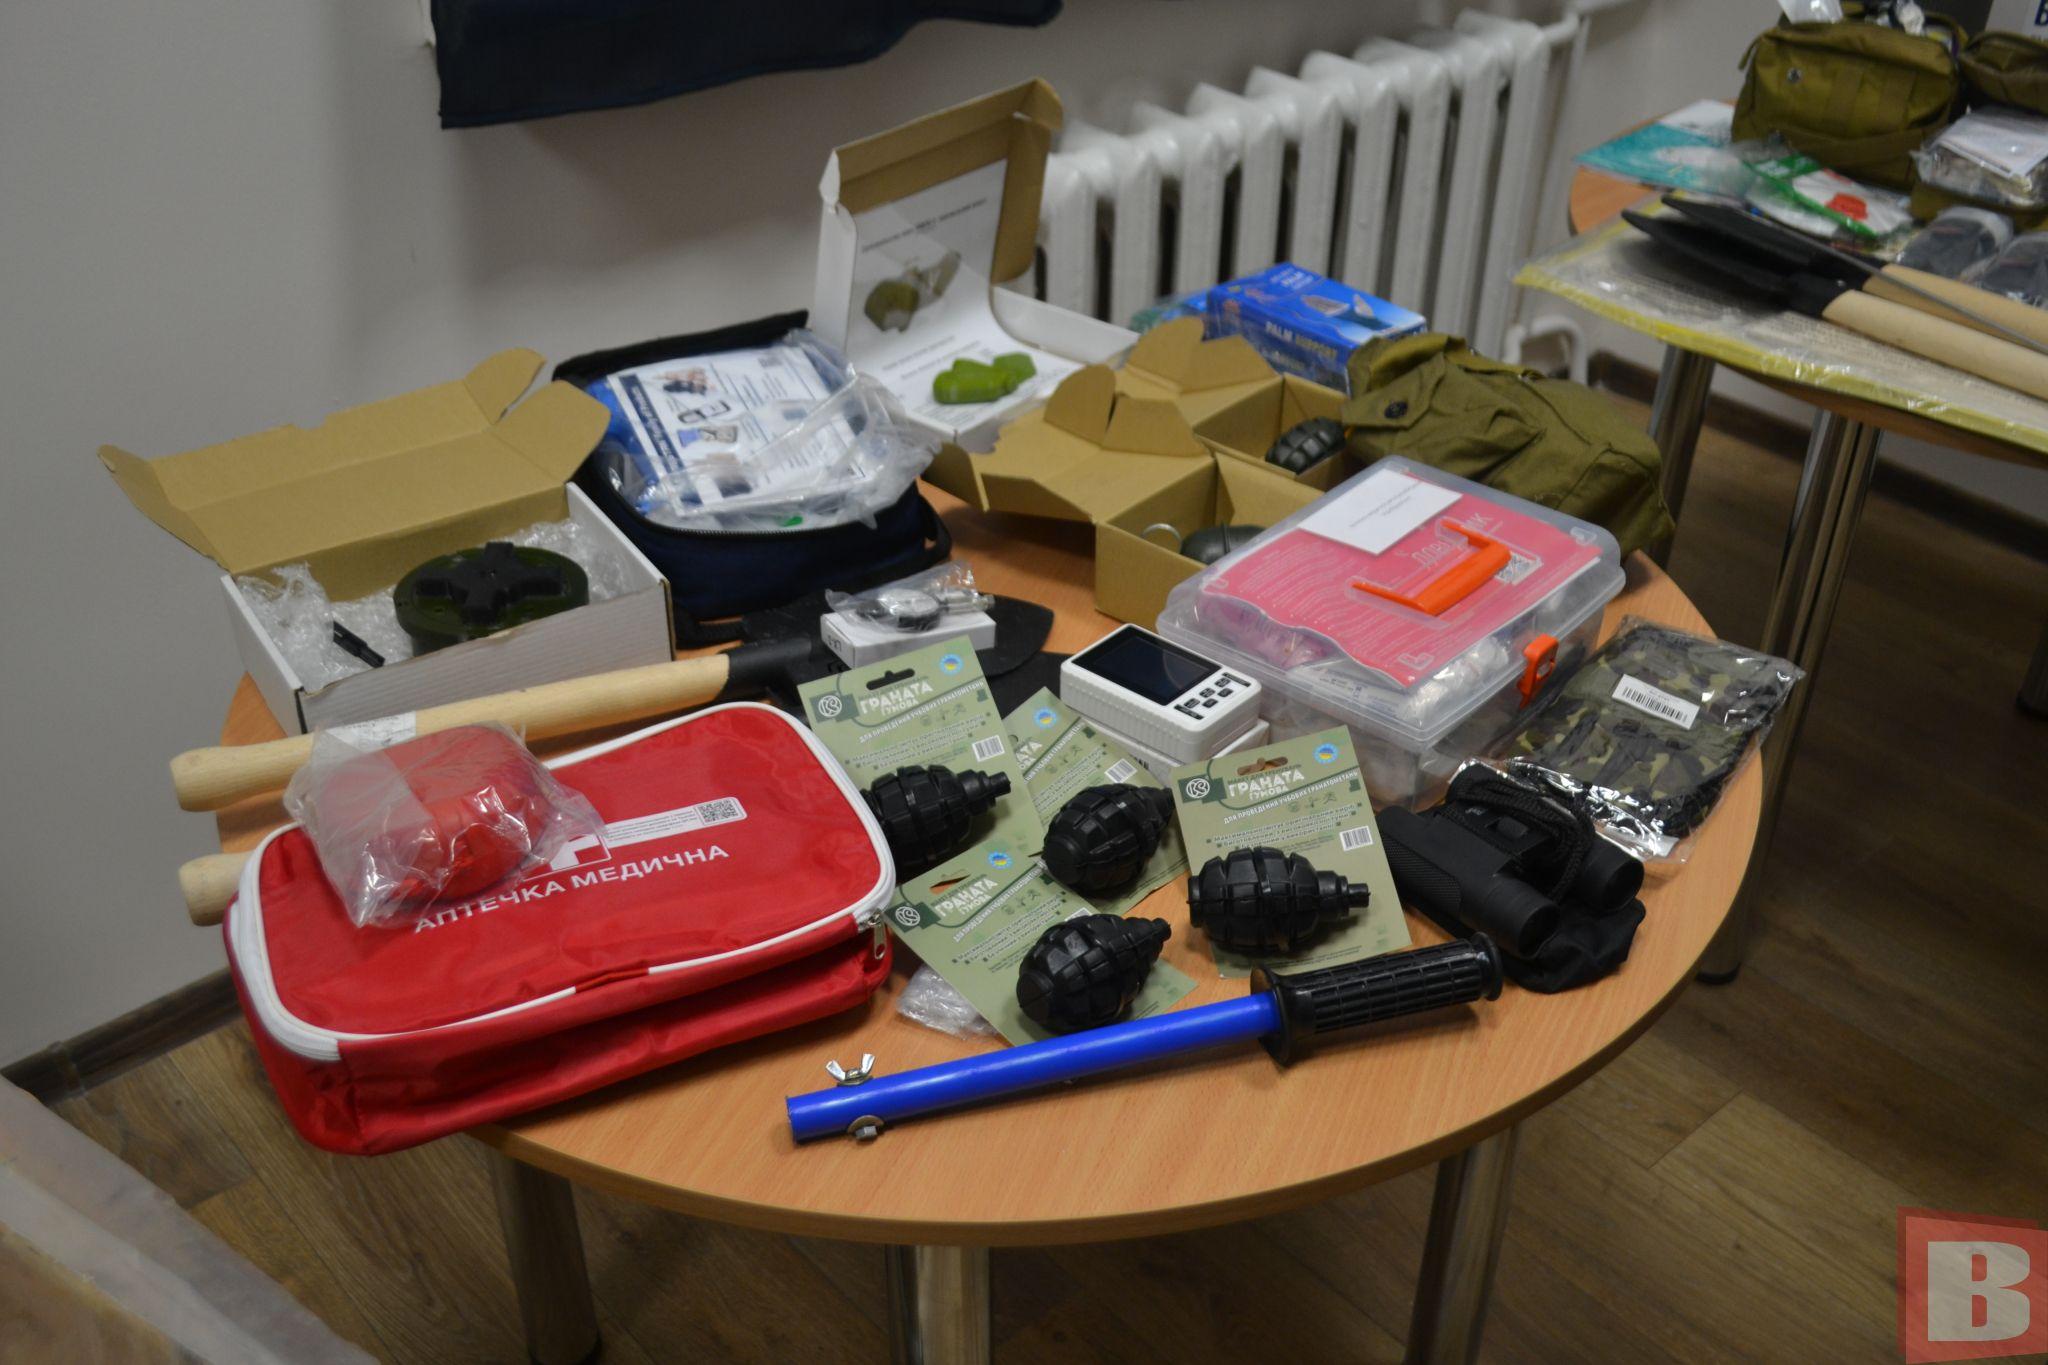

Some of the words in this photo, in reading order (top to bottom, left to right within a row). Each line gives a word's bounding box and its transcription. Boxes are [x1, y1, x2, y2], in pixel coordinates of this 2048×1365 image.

[860, 681, 934, 714] ГРАНАТА
[881, 700, 920, 716] ГУМОВА
[1228, 769, 1305, 797] ГРАНАТА
[1250, 785, 1290, 800] ГУМОВА
[1224, 814, 1237, 824] ДЛЯ
[1239, 801, 1278, 820] ПРОВЕДЕННЯ
[415, 880, 566, 933] АПТЕЧКА
[570, 844, 730, 890] МЕДИЧНА
[934, 878, 998, 917] ГРАНАТА
